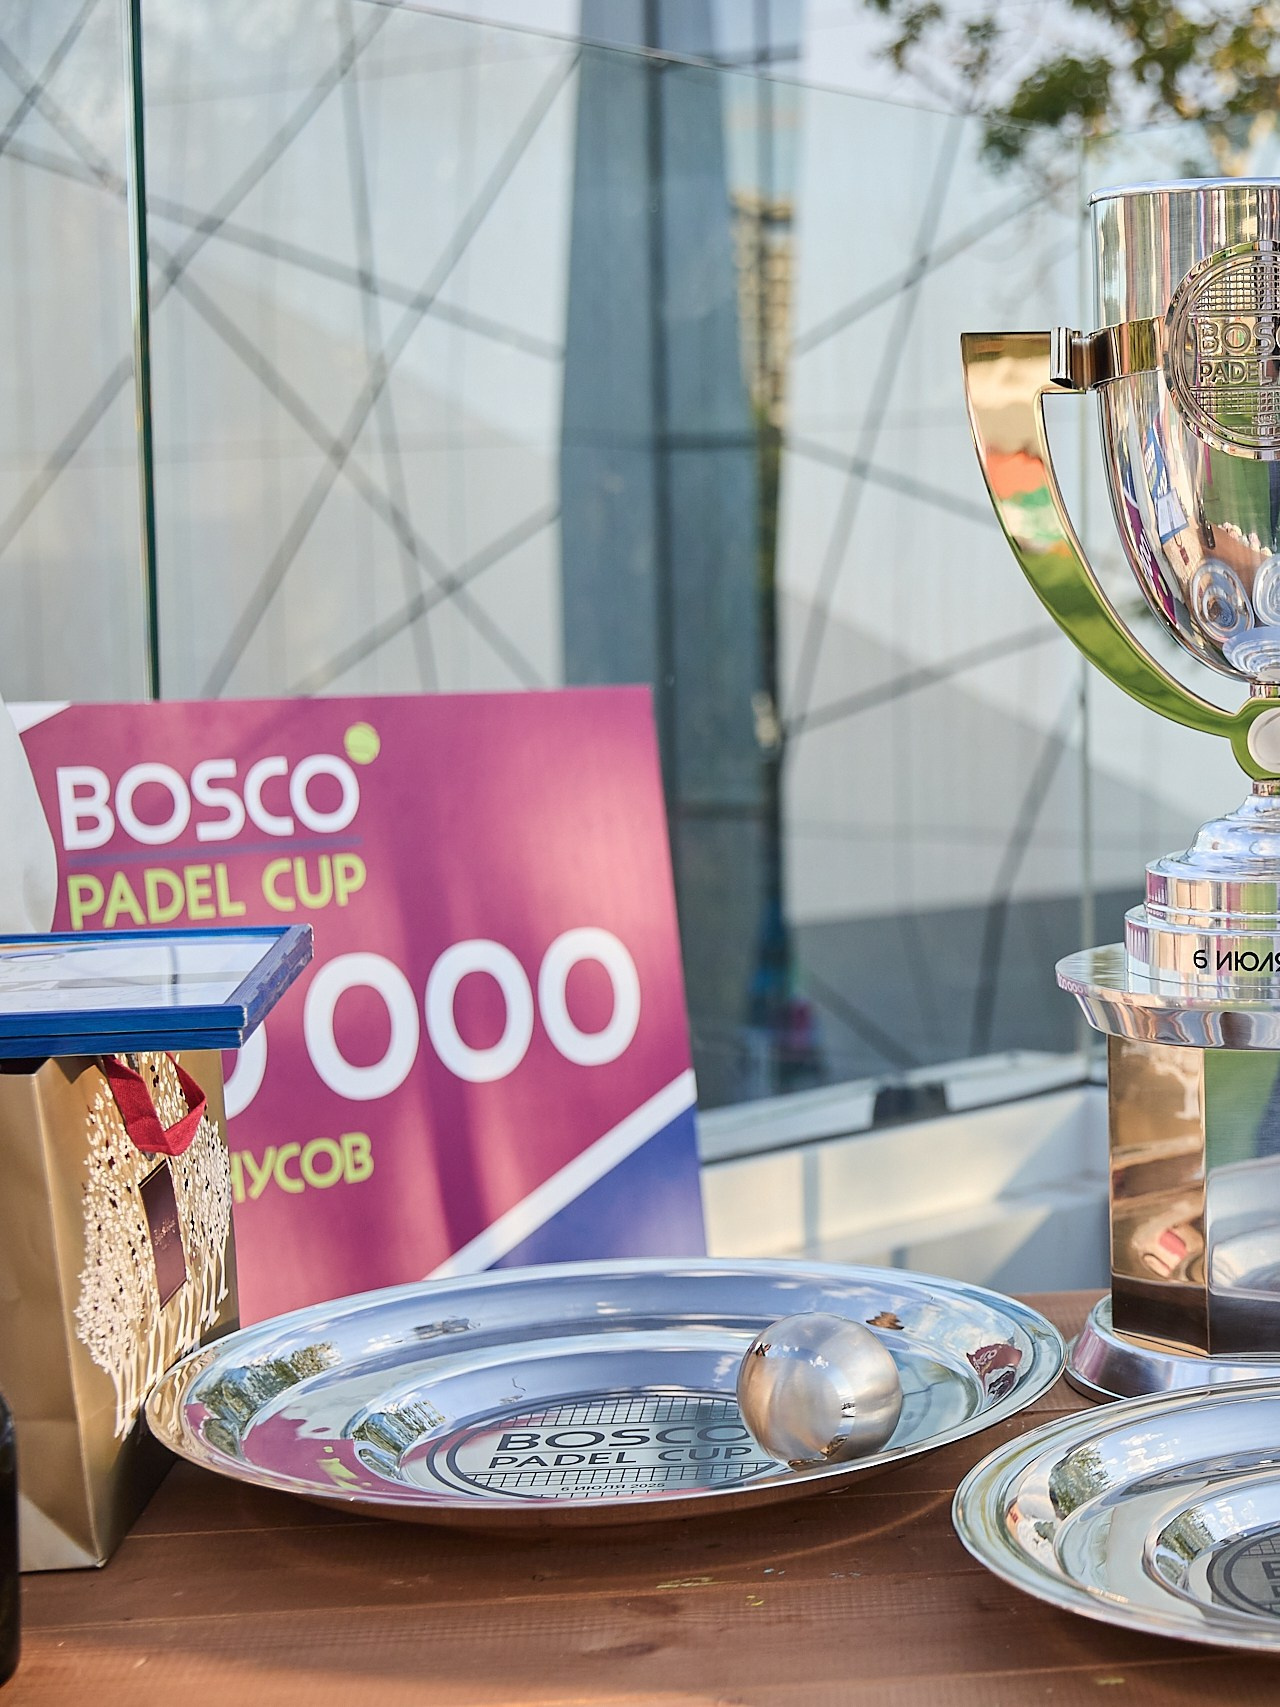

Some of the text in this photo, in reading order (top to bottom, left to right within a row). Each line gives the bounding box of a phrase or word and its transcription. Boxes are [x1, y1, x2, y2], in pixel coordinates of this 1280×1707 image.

[1200, 360, 1272, 385] PADEL
[56, 754, 361, 851] BOSCO
[67, 853, 367, 930] PADEL CUP
[1193, 950, 1208, 969] 6
[496, 1425, 750, 1452] BOSCO
[489, 1446, 752, 1469] PADEL CUP
